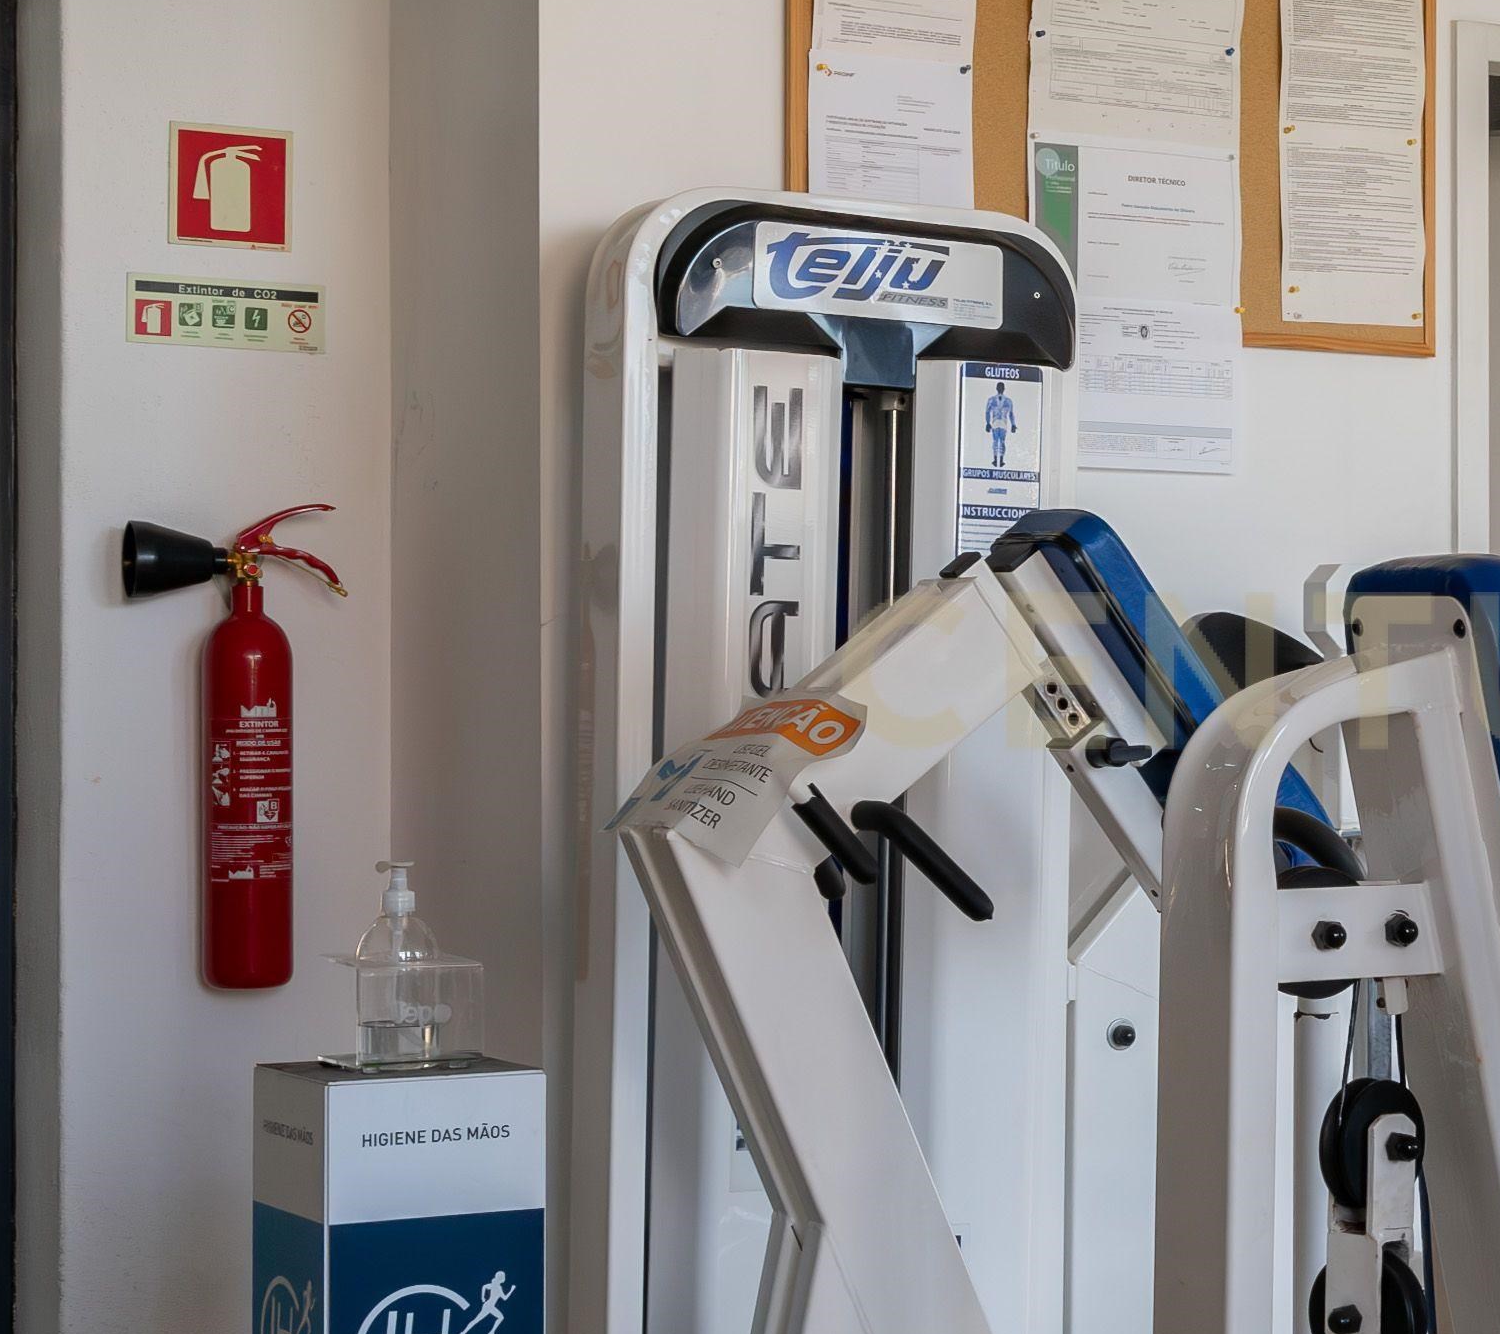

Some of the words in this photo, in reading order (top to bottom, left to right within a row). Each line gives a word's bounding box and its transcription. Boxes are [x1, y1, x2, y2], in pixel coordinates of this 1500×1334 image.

[1127, 175, 1156, 184] DIRETOR
[178, 284, 224, 297] Extintor
[232, 289, 246, 298] de
[253, 289, 278, 300] CO2
[881, 293, 947, 308] FITNESS
[984, 366, 1020, 379] GLUTEOS
[962, 468, 990, 478] GRUPOS
[993, 470, 1036, 481] MUSCULARES
[668, 799, 722, 829] SANITIZER
[362, 1129, 427, 1148] HIGIENE
[431, 1128, 462, 1143] DAS
[466, 1124, 510, 1140] MÃOS
